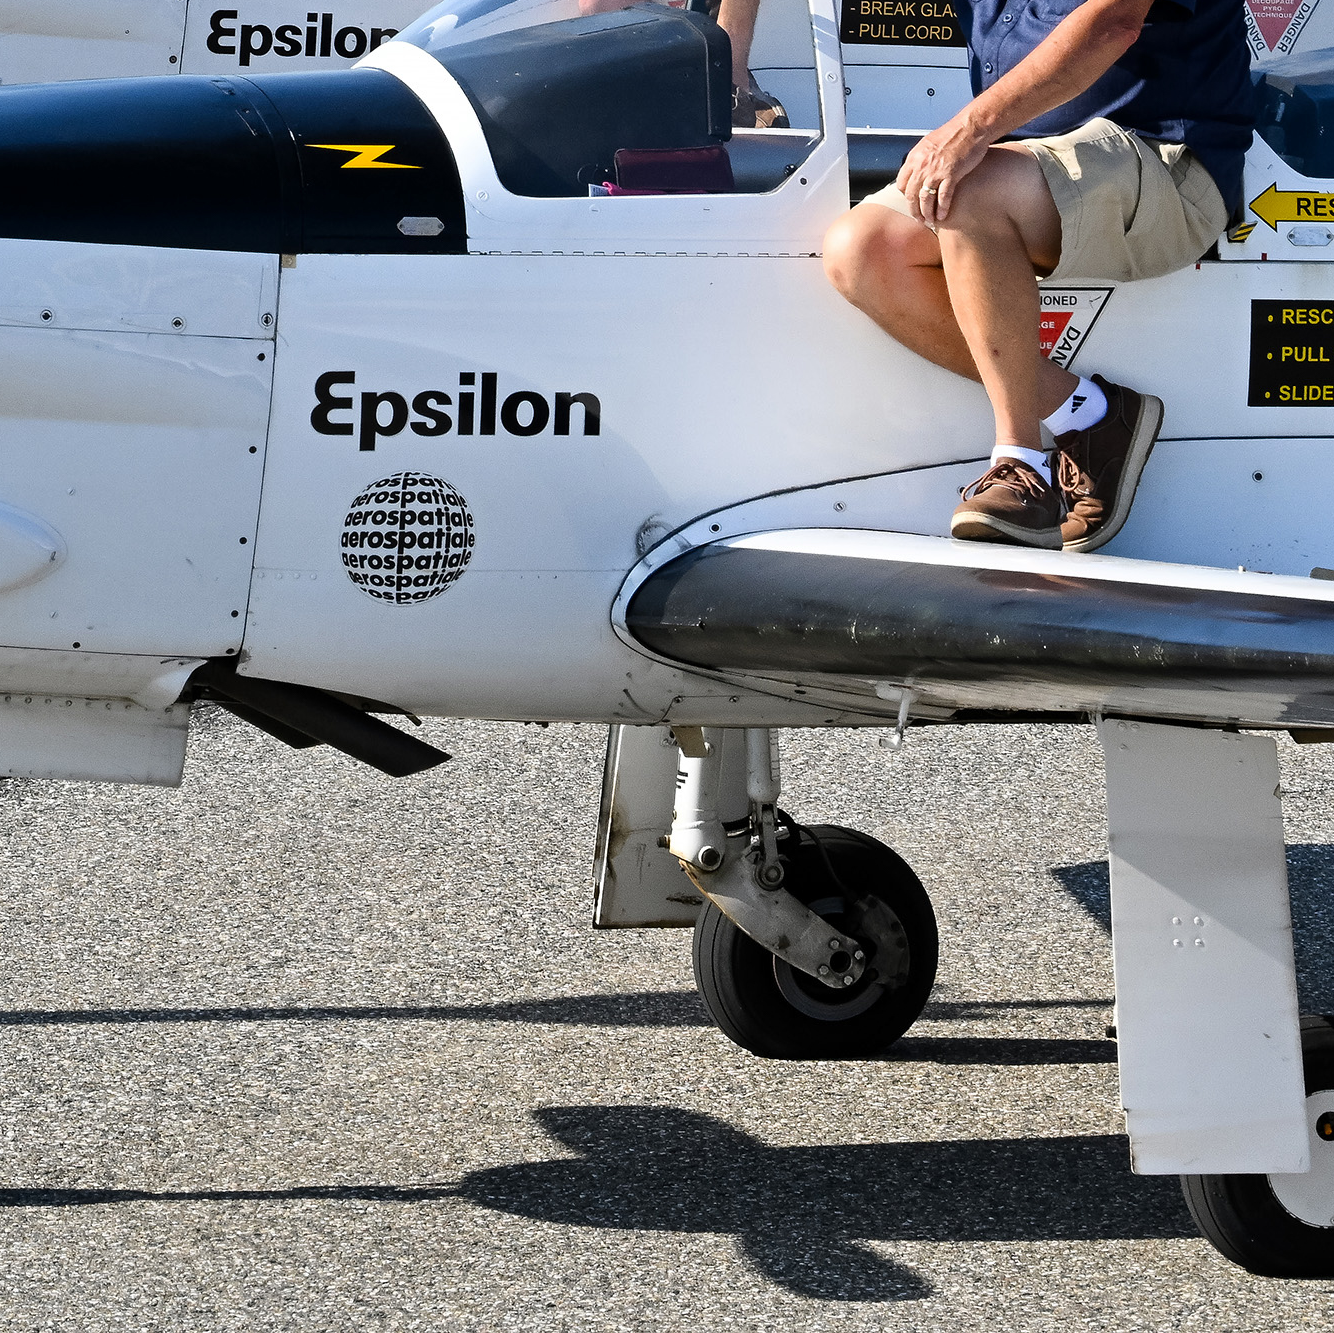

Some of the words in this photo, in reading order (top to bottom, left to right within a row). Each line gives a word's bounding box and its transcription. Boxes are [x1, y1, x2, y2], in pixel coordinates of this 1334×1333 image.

[860, 0, 916, 17] BREAK
[920, 2, 957, 18] GLA
[859, 23, 900, 39] PULL
[904, 24, 953, 41] CORD
[1277, 2, 1311, 53] DANGER
[1051, 325, 1082, 366] DAN
[1281, 346, 1330, 362] PULL
[1278, 385, 1334, 401] SLIDE
[310, 370, 601, 452] Epsilon
[344, 506, 474, 530] aerospatiale
[341, 526, 475, 555] aerospatiale
[342, 548, 472, 574] aerospatiale
